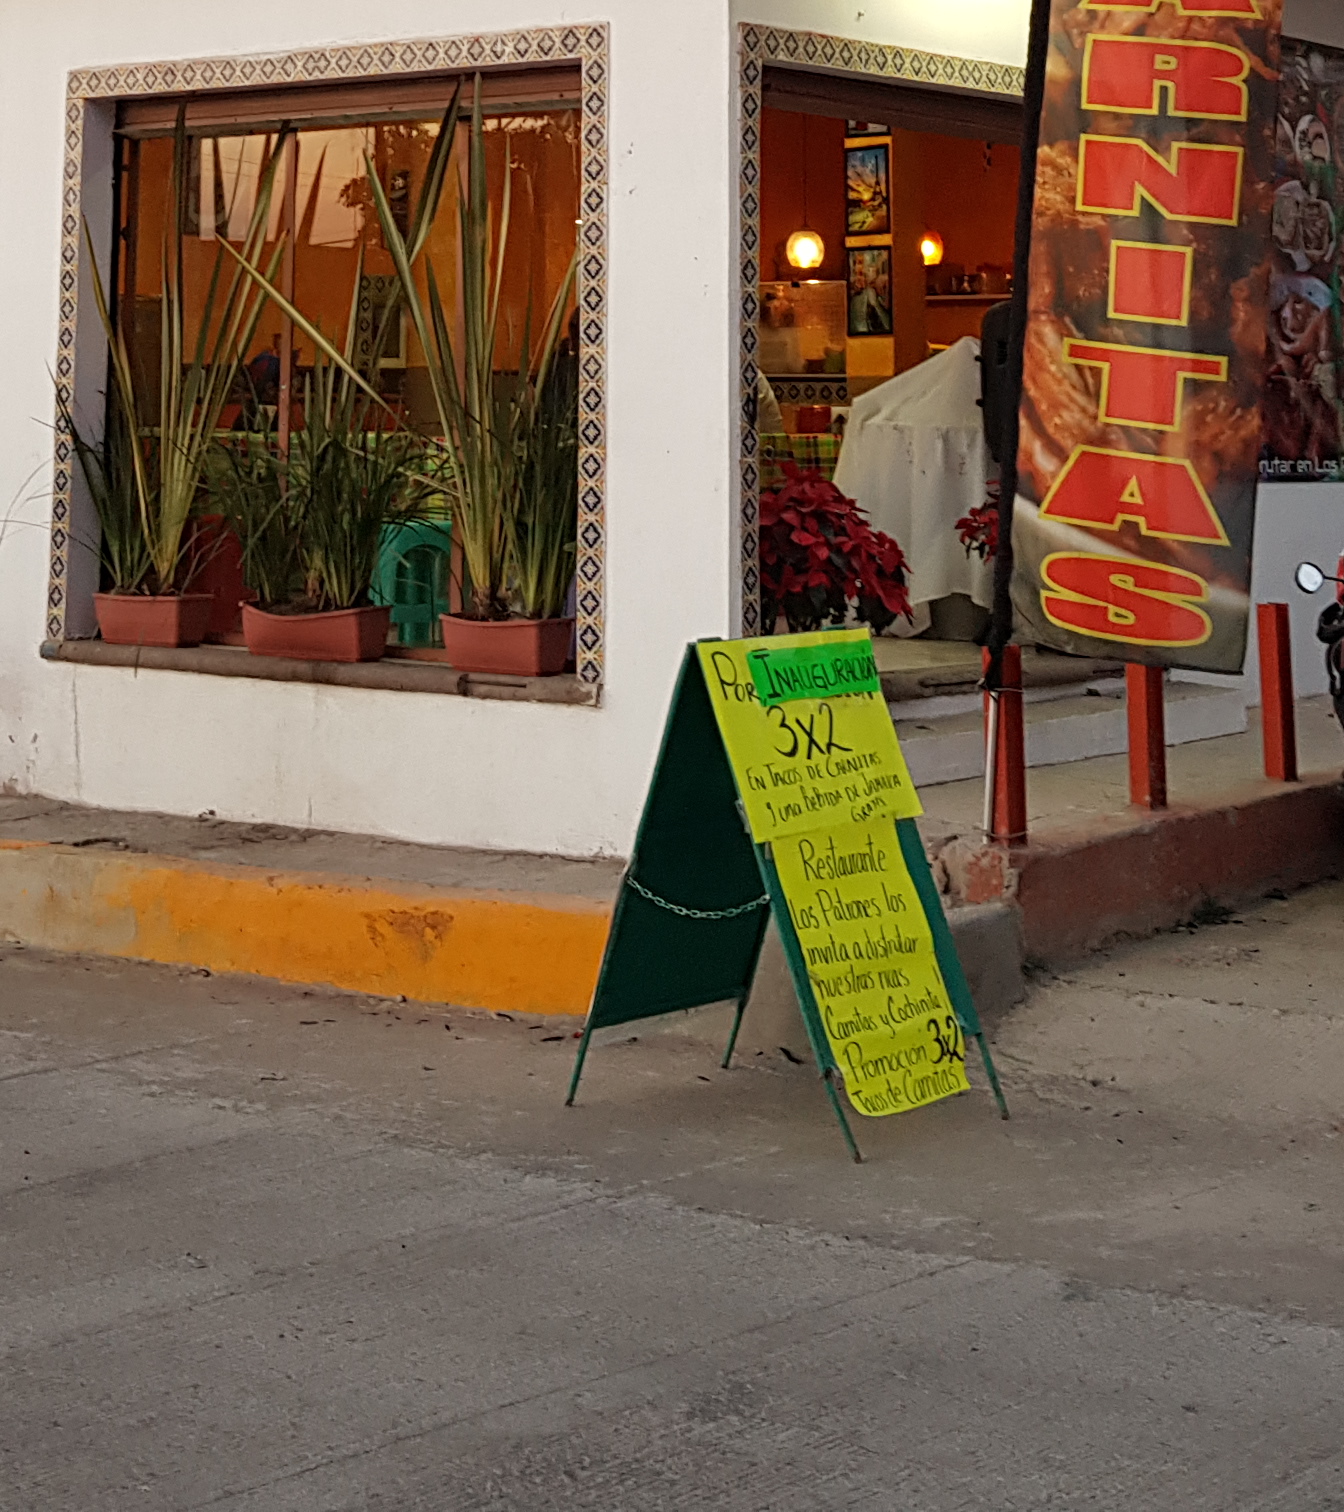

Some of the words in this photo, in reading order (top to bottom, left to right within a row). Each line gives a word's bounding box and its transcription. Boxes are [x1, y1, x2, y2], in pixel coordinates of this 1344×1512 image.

[1314, 455, 1339, 474] Los
[806, 763, 824, 780] DE
[798, 833, 888, 881] Restaurante
[789, 899, 820, 930] Los
[815, 887, 882, 927] Patrones
[806, 932, 851, 966] invita
[852, 941, 864, 958] a
[818, 964, 875, 1000] nuestras
[824, 1005, 878, 1040] Carnitas
[879, 1013, 896, 1039] y
[927, 1015, 965, 1064] 3x2
[886, 1079, 903, 1109] de
[903, 1066, 961, 1105] Carnitas
